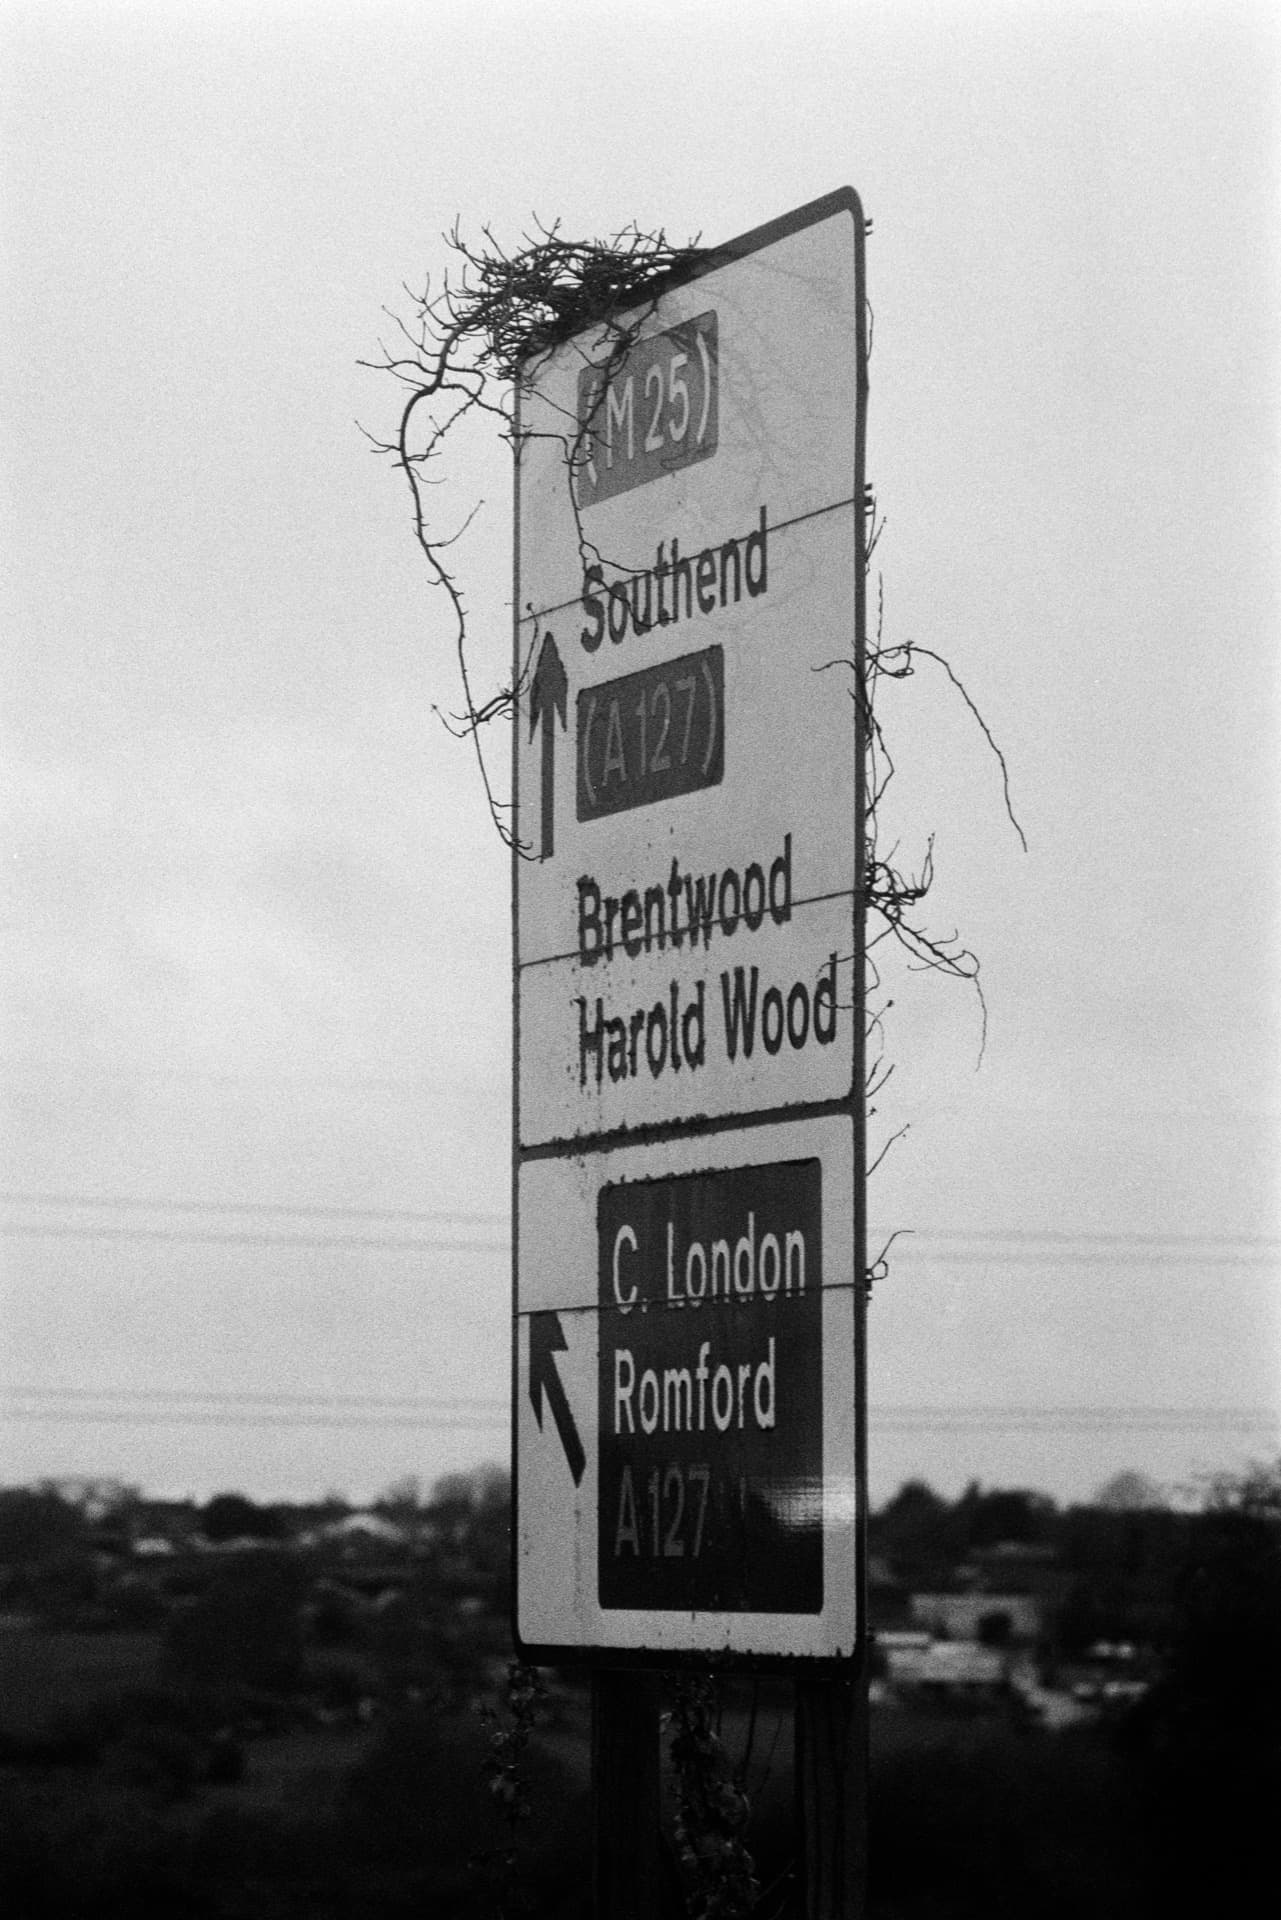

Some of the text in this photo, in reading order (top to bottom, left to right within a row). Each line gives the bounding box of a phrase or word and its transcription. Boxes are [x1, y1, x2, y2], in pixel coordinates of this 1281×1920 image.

[581, 505, 768, 653] Southend
[576, 833, 791, 968] Brentwood
[574, 952, 837, 1094] Harold Wood
[612, 1211, 806, 1314] C. London
[613, 1337, 775, 1434] Romford
[614, 1463, 710, 1558] A127
